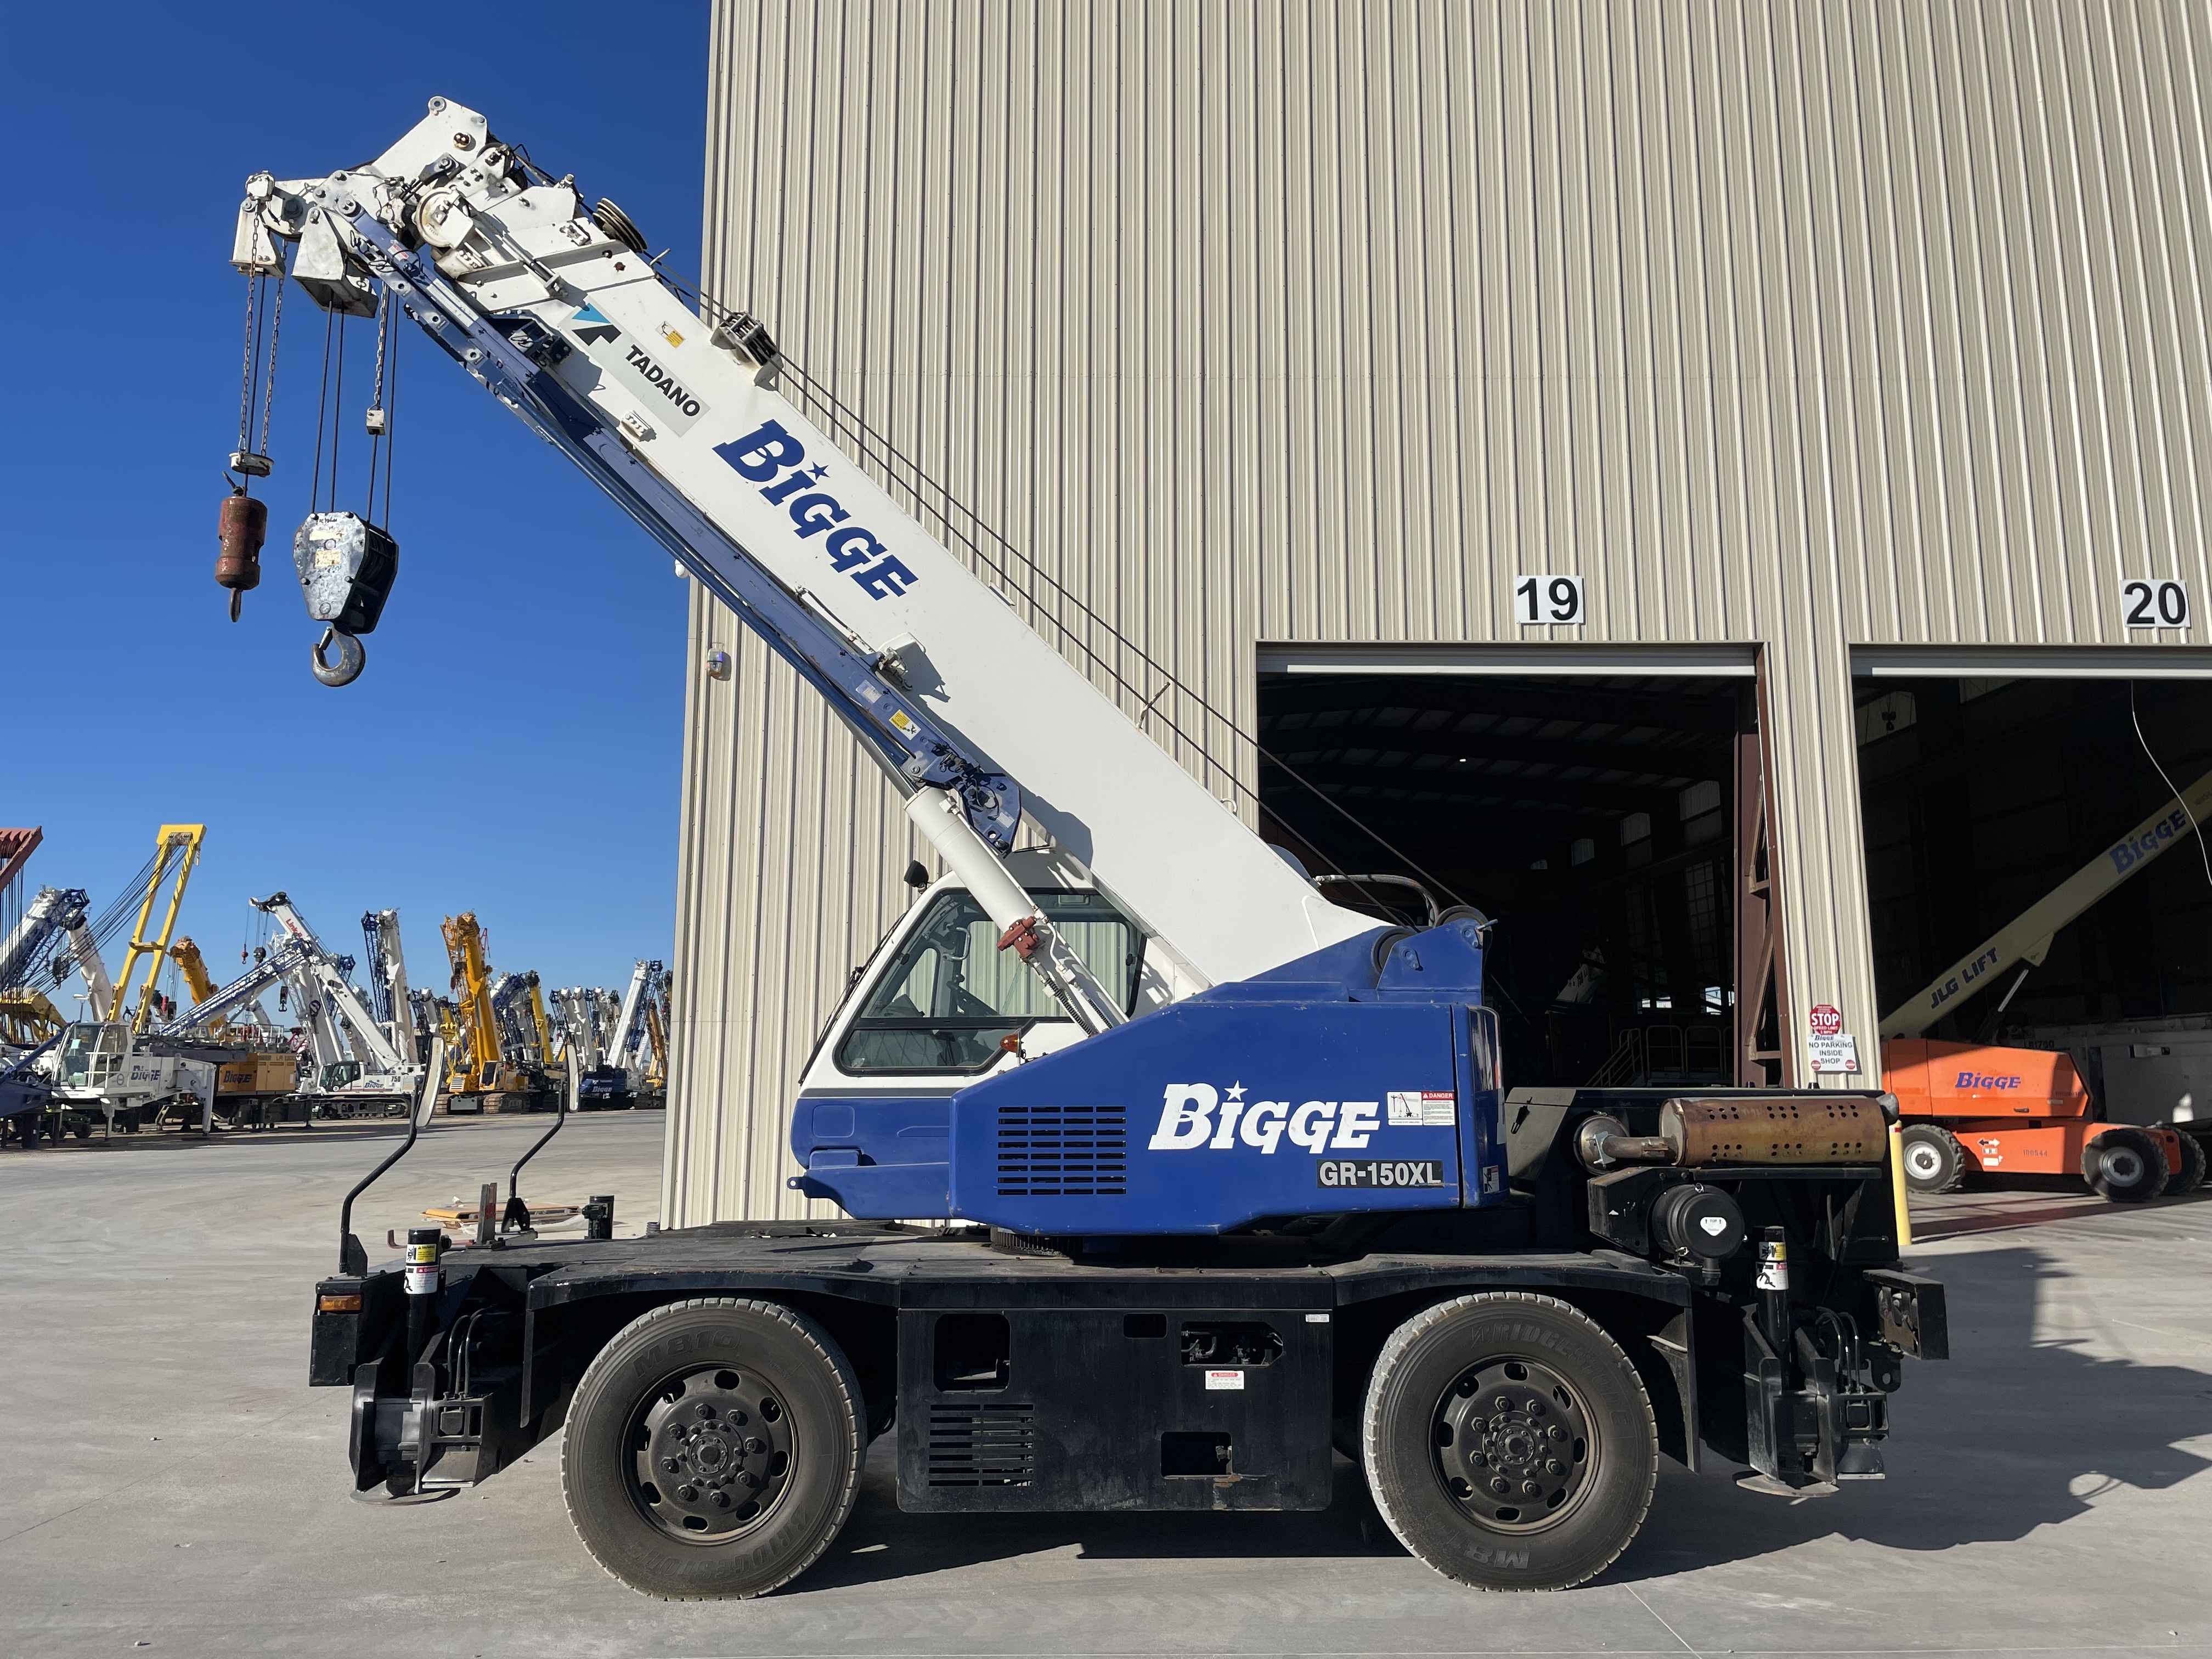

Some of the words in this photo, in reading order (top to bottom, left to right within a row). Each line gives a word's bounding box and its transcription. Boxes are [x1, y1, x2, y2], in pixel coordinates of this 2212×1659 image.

[625, 344, 701, 417] TADANO
[712, 419, 919, 601] BIGGE
[1517, 578, 1578, 621] 19
[2124, 582, 2187, 625] 20
[1931, 977, 1959, 1009] JLG
[1961, 946, 1997, 984] LIFT
[1811, 1013, 1839, 1026] STOP
[1148, 1080, 1381, 1154] BIGGE
[1319, 1161, 1442, 1187] GR-150XL
